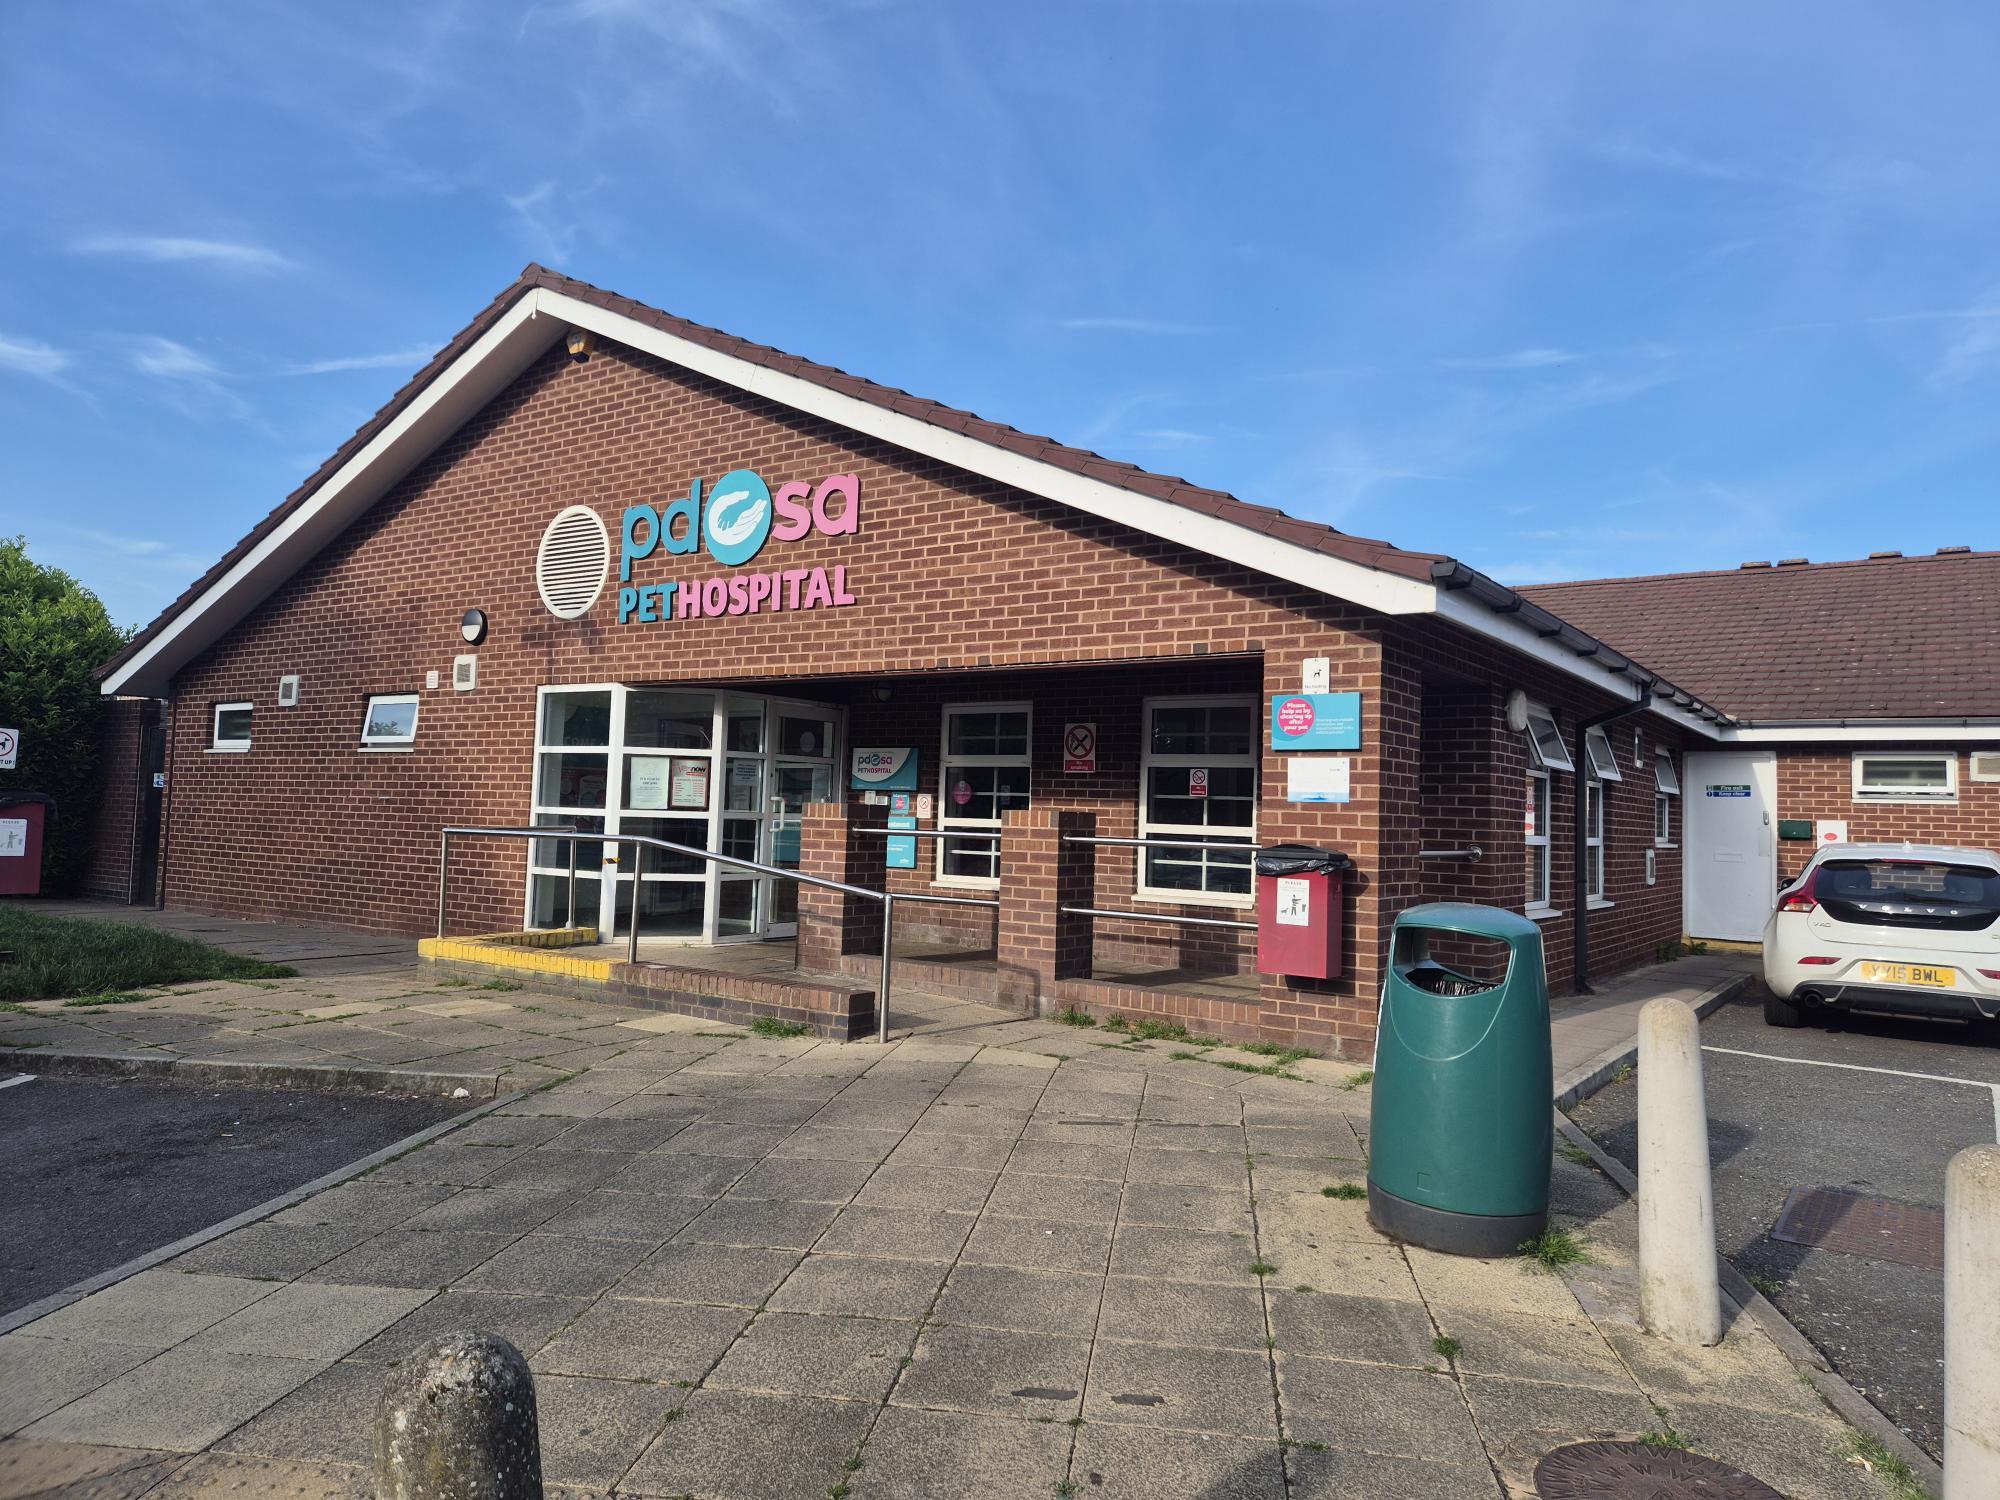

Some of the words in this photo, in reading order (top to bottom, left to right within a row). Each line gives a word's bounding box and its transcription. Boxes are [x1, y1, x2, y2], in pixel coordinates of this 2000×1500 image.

[620, 469, 860, 582] pdsa
[1858, 903, 1959, 916] VOLVO
[1871, 964, 1907, 980] YY15
[1911, 968, 1944, 983] BWL
